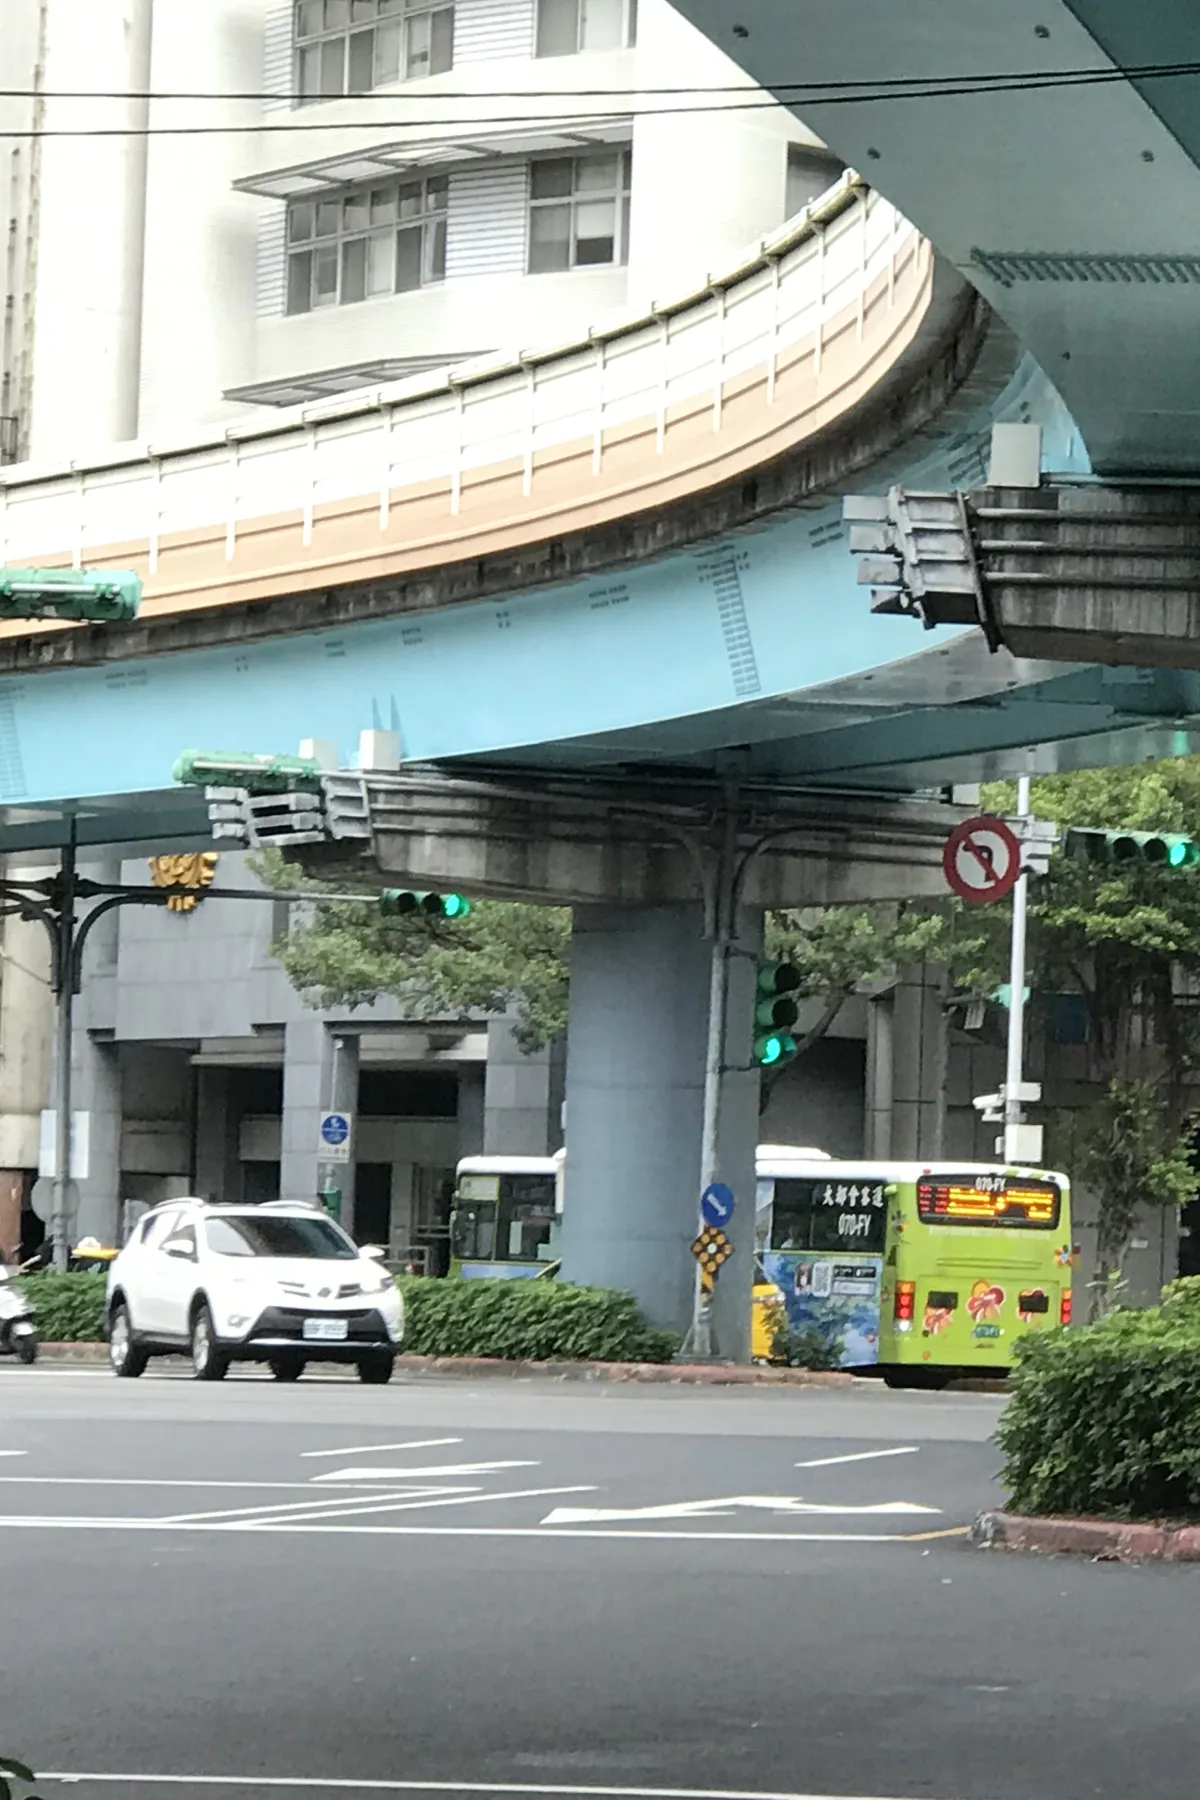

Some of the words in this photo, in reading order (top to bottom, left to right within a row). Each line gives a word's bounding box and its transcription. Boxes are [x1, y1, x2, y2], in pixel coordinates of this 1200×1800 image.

[822, 1184, 884, 1208] 大都會客運
